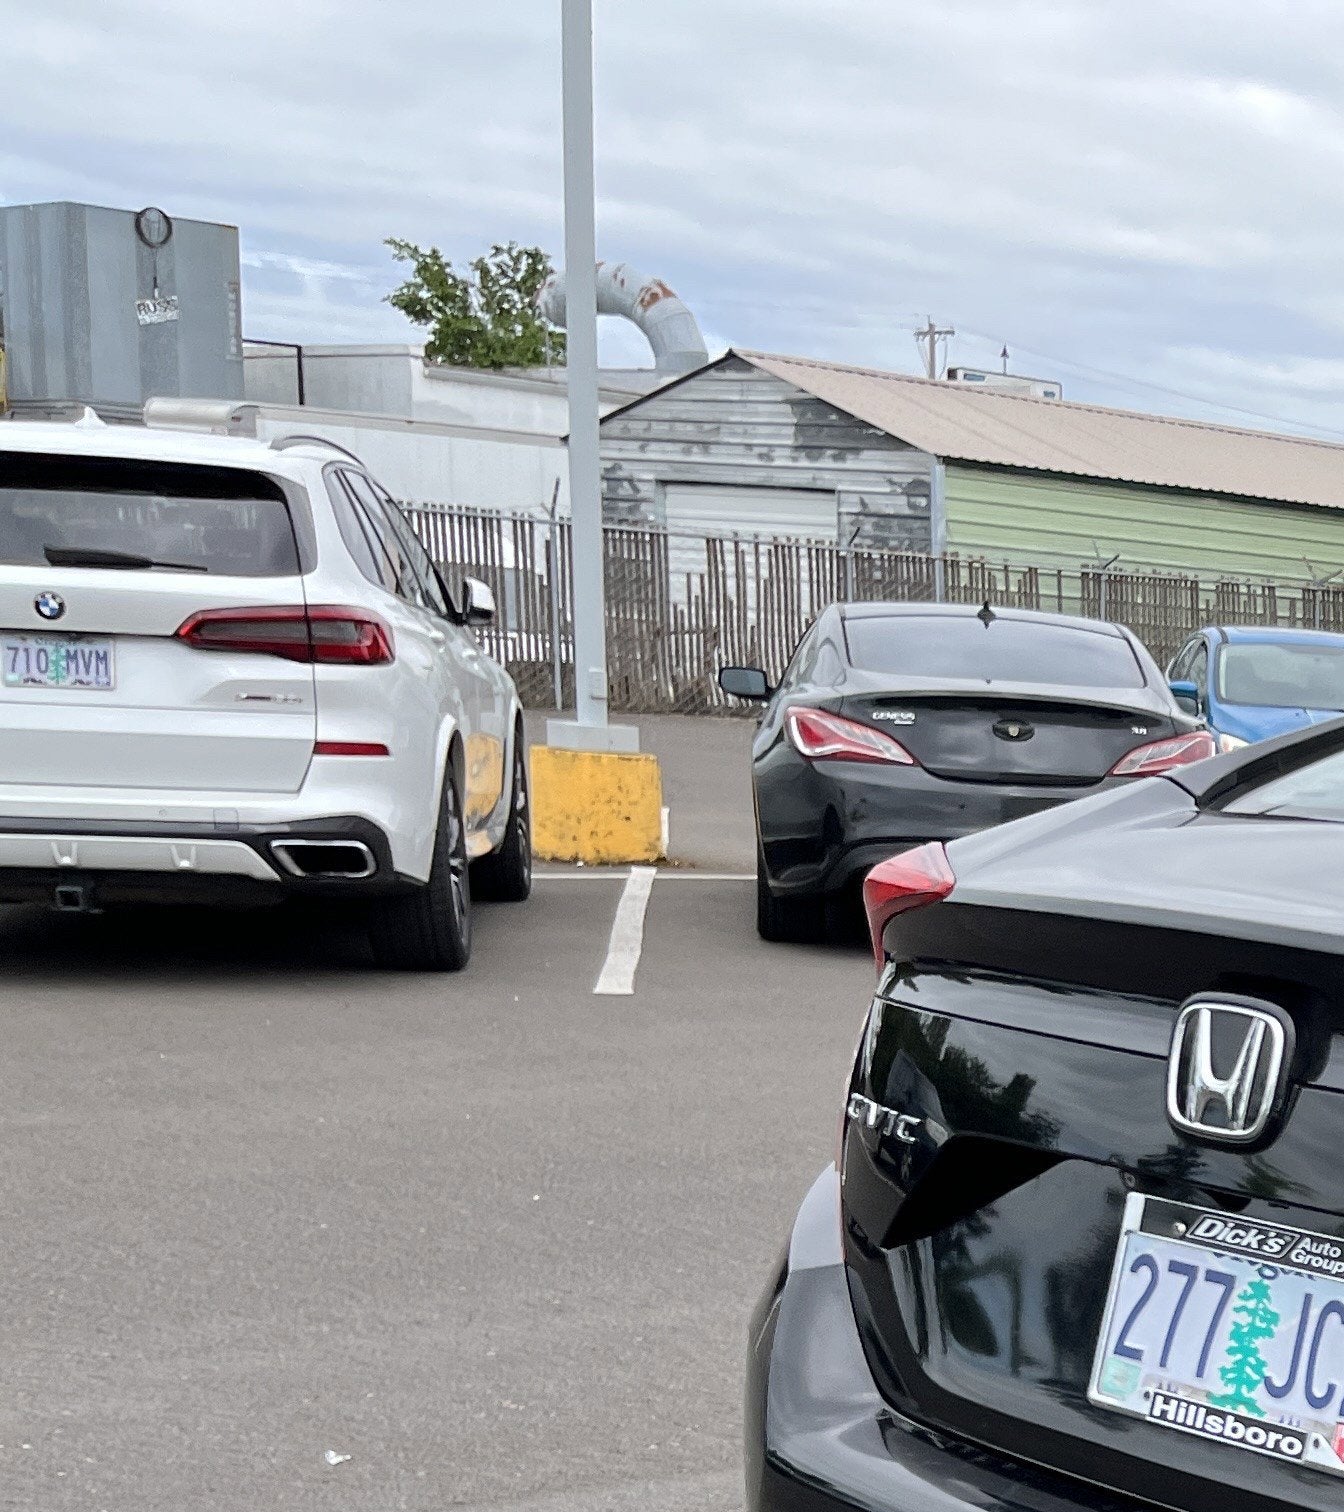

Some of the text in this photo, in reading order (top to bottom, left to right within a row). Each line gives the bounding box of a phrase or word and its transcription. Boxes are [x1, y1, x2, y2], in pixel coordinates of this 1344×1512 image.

[6, 646, 108, 676] 710 MVM
[1194, 1218, 1286, 1254] Dick's
[1297, 1237, 1342, 1259] Auto
[1113, 1253, 1237, 1379] 277
[1152, 1394, 1303, 1456] Hillsboro
